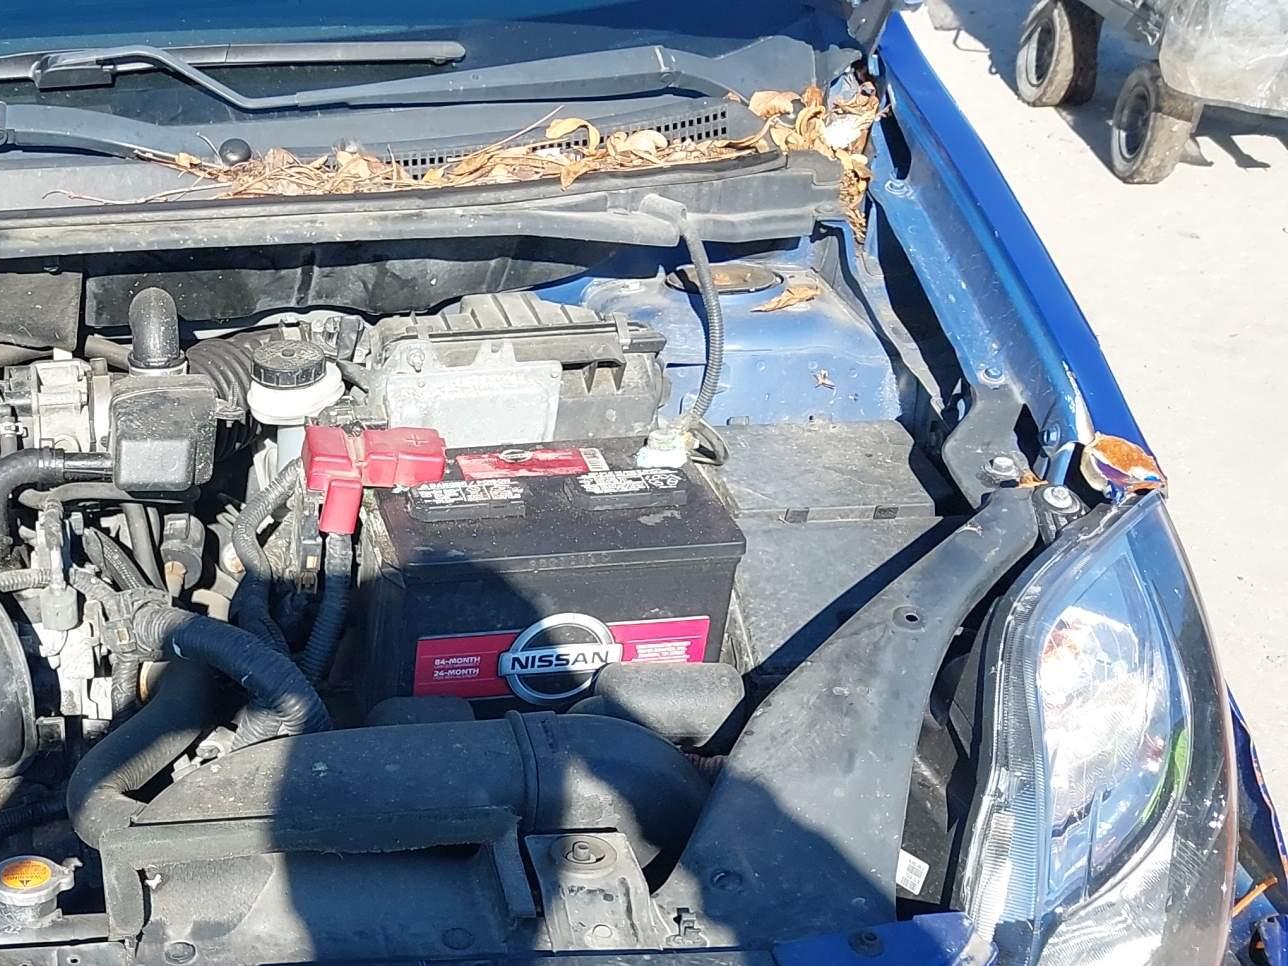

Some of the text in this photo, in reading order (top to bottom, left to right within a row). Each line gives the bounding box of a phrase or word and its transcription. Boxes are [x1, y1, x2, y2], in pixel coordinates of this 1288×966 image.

[434, 656, 481, 666] 84-MONTH
[511, 651, 609, 670] NISSAN
[433, 668, 480, 677] 24-MONTH
